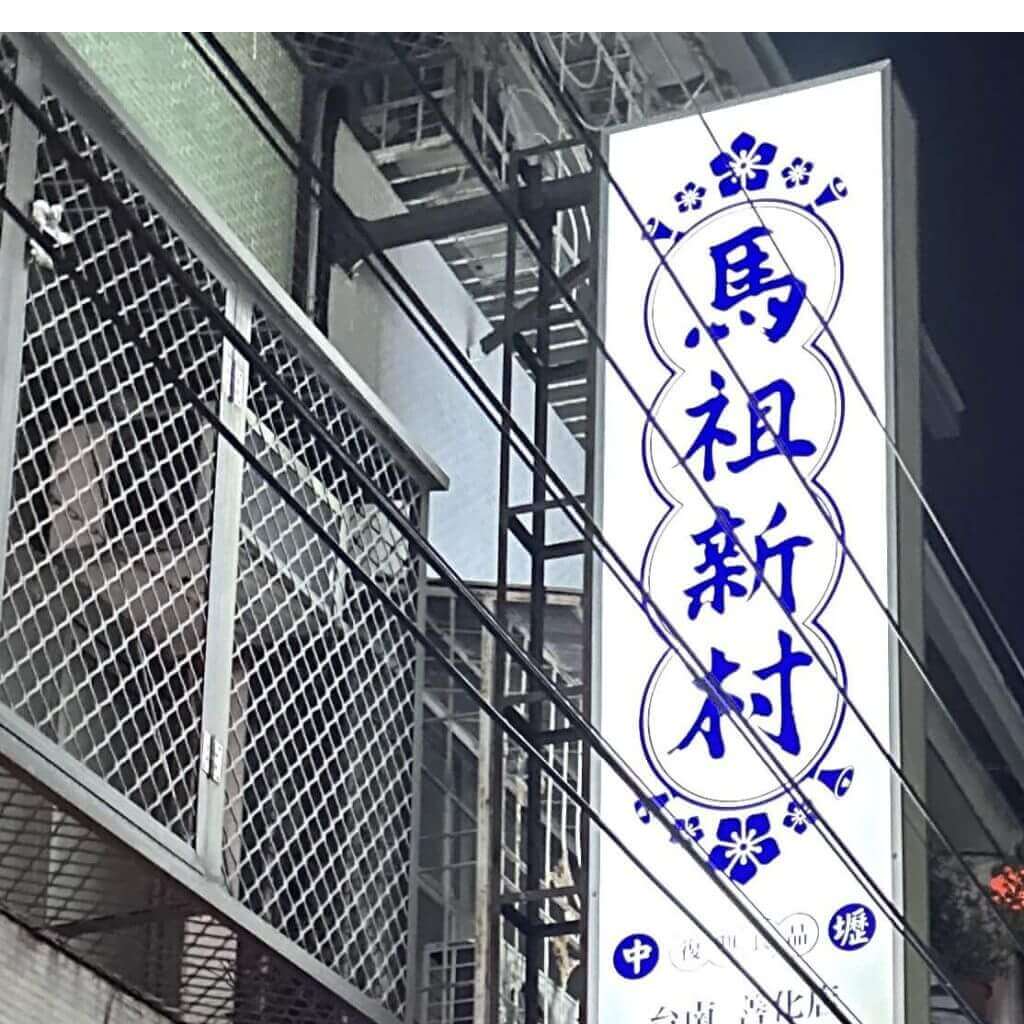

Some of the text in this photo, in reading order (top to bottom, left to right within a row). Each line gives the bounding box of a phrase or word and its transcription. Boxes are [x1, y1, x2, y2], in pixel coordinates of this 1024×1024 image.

[667, 226, 817, 759] 馬祖新村
[619, 936, 654, 976] 中
